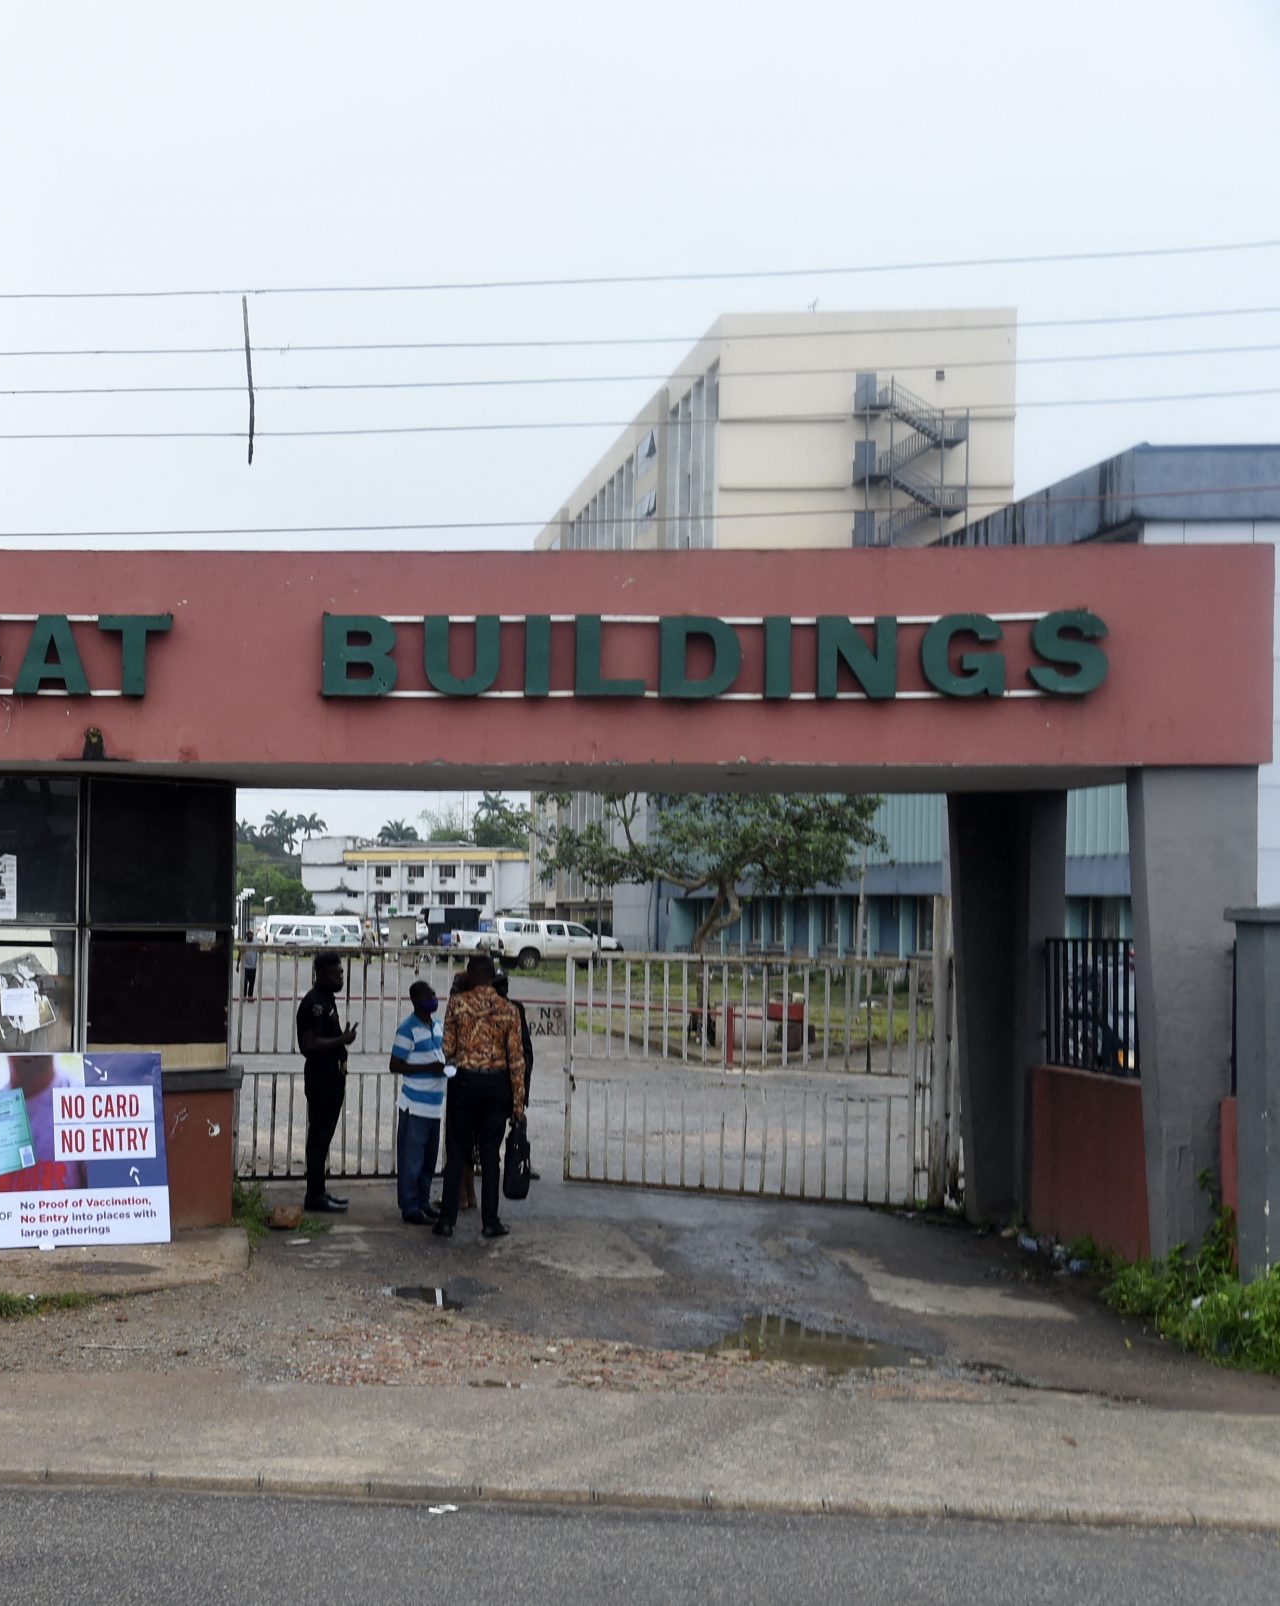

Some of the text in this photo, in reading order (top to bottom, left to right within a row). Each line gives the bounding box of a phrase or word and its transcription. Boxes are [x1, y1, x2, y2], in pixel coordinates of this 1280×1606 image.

[321, 609, 1109, 698] BUILDINGS
[540, 1007, 562, 1020] NO
[61, 1094, 139, 1119] NO CARD
[61, 1127, 148, 1153] NO ENTRY
[20, 1196, 152, 1210] No Proof of Vaccination,
[20, 1208, 157, 1224] No Entry into places with
[20, 1224, 111, 1238] large gatherings
